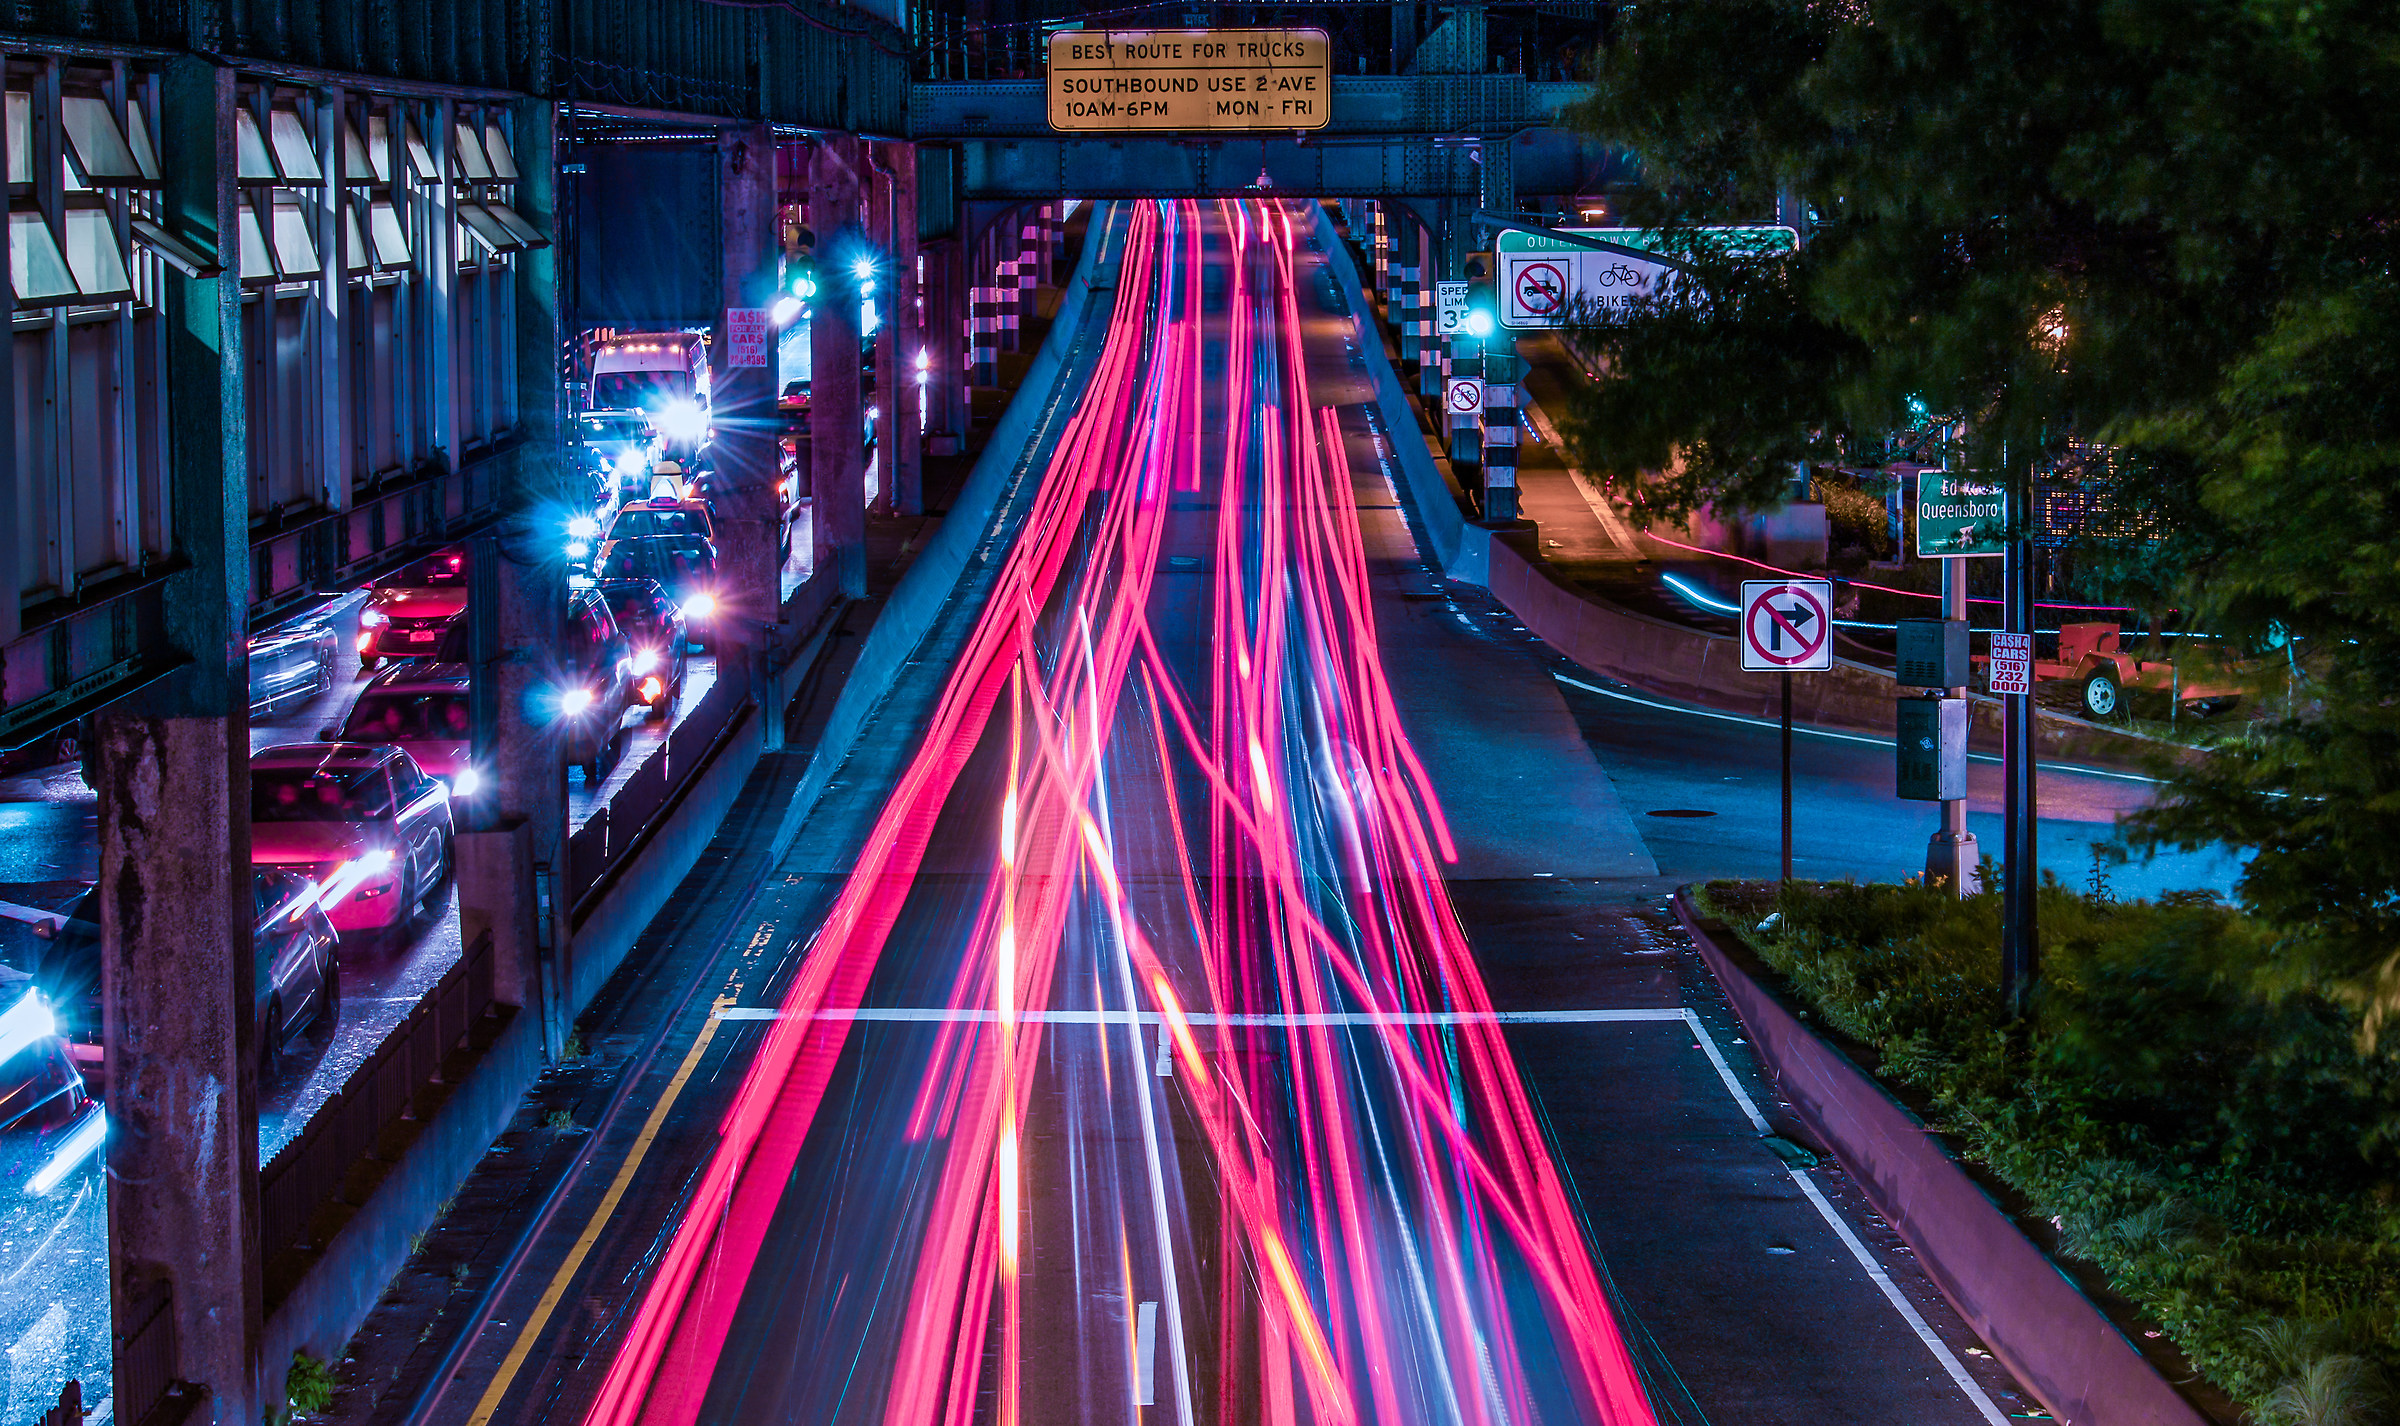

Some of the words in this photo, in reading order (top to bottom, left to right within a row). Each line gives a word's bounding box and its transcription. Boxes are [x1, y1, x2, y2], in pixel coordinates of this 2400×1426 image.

[1072, 44, 1115, 60] BEST
[1126, 44, 1183, 59] ROUTE
[1193, 43, 1227, 58] FOR
[1237, 42, 1305, 58] TRUCKS
[1063, 78, 1199, 94] SOUTHBOUND
[1208, 77, 1247, 92] USE
[1256, 76, 1268, 92] 2
[1278, 76, 1317, 91] AVE
[1066, 101, 1169, 117] 10AM-6PM
[1217, 100, 1260, 115] MON
[1282, 100, 1313, 115] FRI
[1441, 286, 1469, 296] SPEE
[737, 345, 758, 355] (516)
[1942, 479, 1958, 497] Ed
[1921, 500, 1998, 520] Queensboro
[1993, 647, 2028, 661] CARS
[1994, 660, 2026, 673] (516)
[1995, 670, 2024, 682] 232
[1991, 680, 2028, 693] 0007
